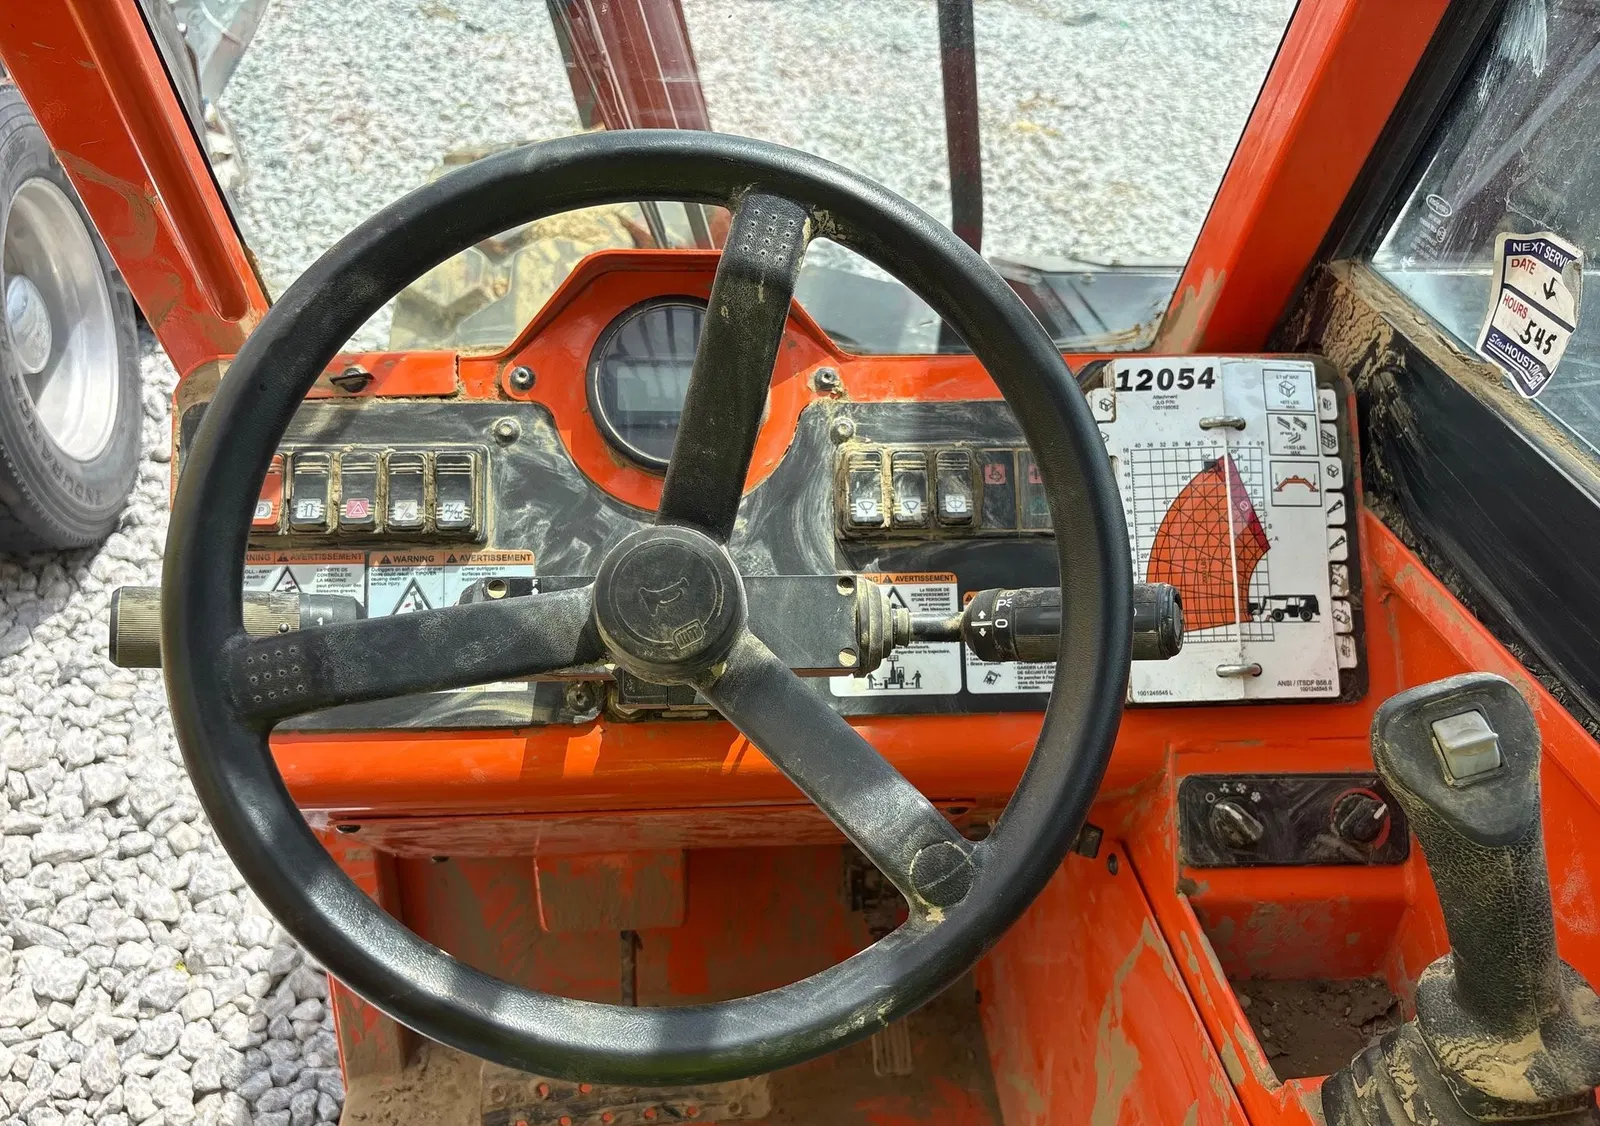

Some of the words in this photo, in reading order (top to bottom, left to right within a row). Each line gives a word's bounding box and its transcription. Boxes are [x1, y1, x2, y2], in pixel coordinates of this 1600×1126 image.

[1512, 242, 1544, 254] NEXT
[1544, 246, 1572, 269] SERVI
[1511, 258, 1537, 276] DATE
[1502, 293, 1528, 320] HOURS
[1519, 319, 1557, 356] 545
[1115, 366, 1216, 392] 12054
[290, 553, 362, 561] AVERTISSEMENT
[393, 555, 434, 563] WARNING
[459, 554, 532, 562] AVERTISSEMENT
[532, 579, 538, 587] F
[894, 574, 954, 582] AVERTISSEMENT
[996, 599, 1006, 611] P
[317, 616, 324, 626] 1
